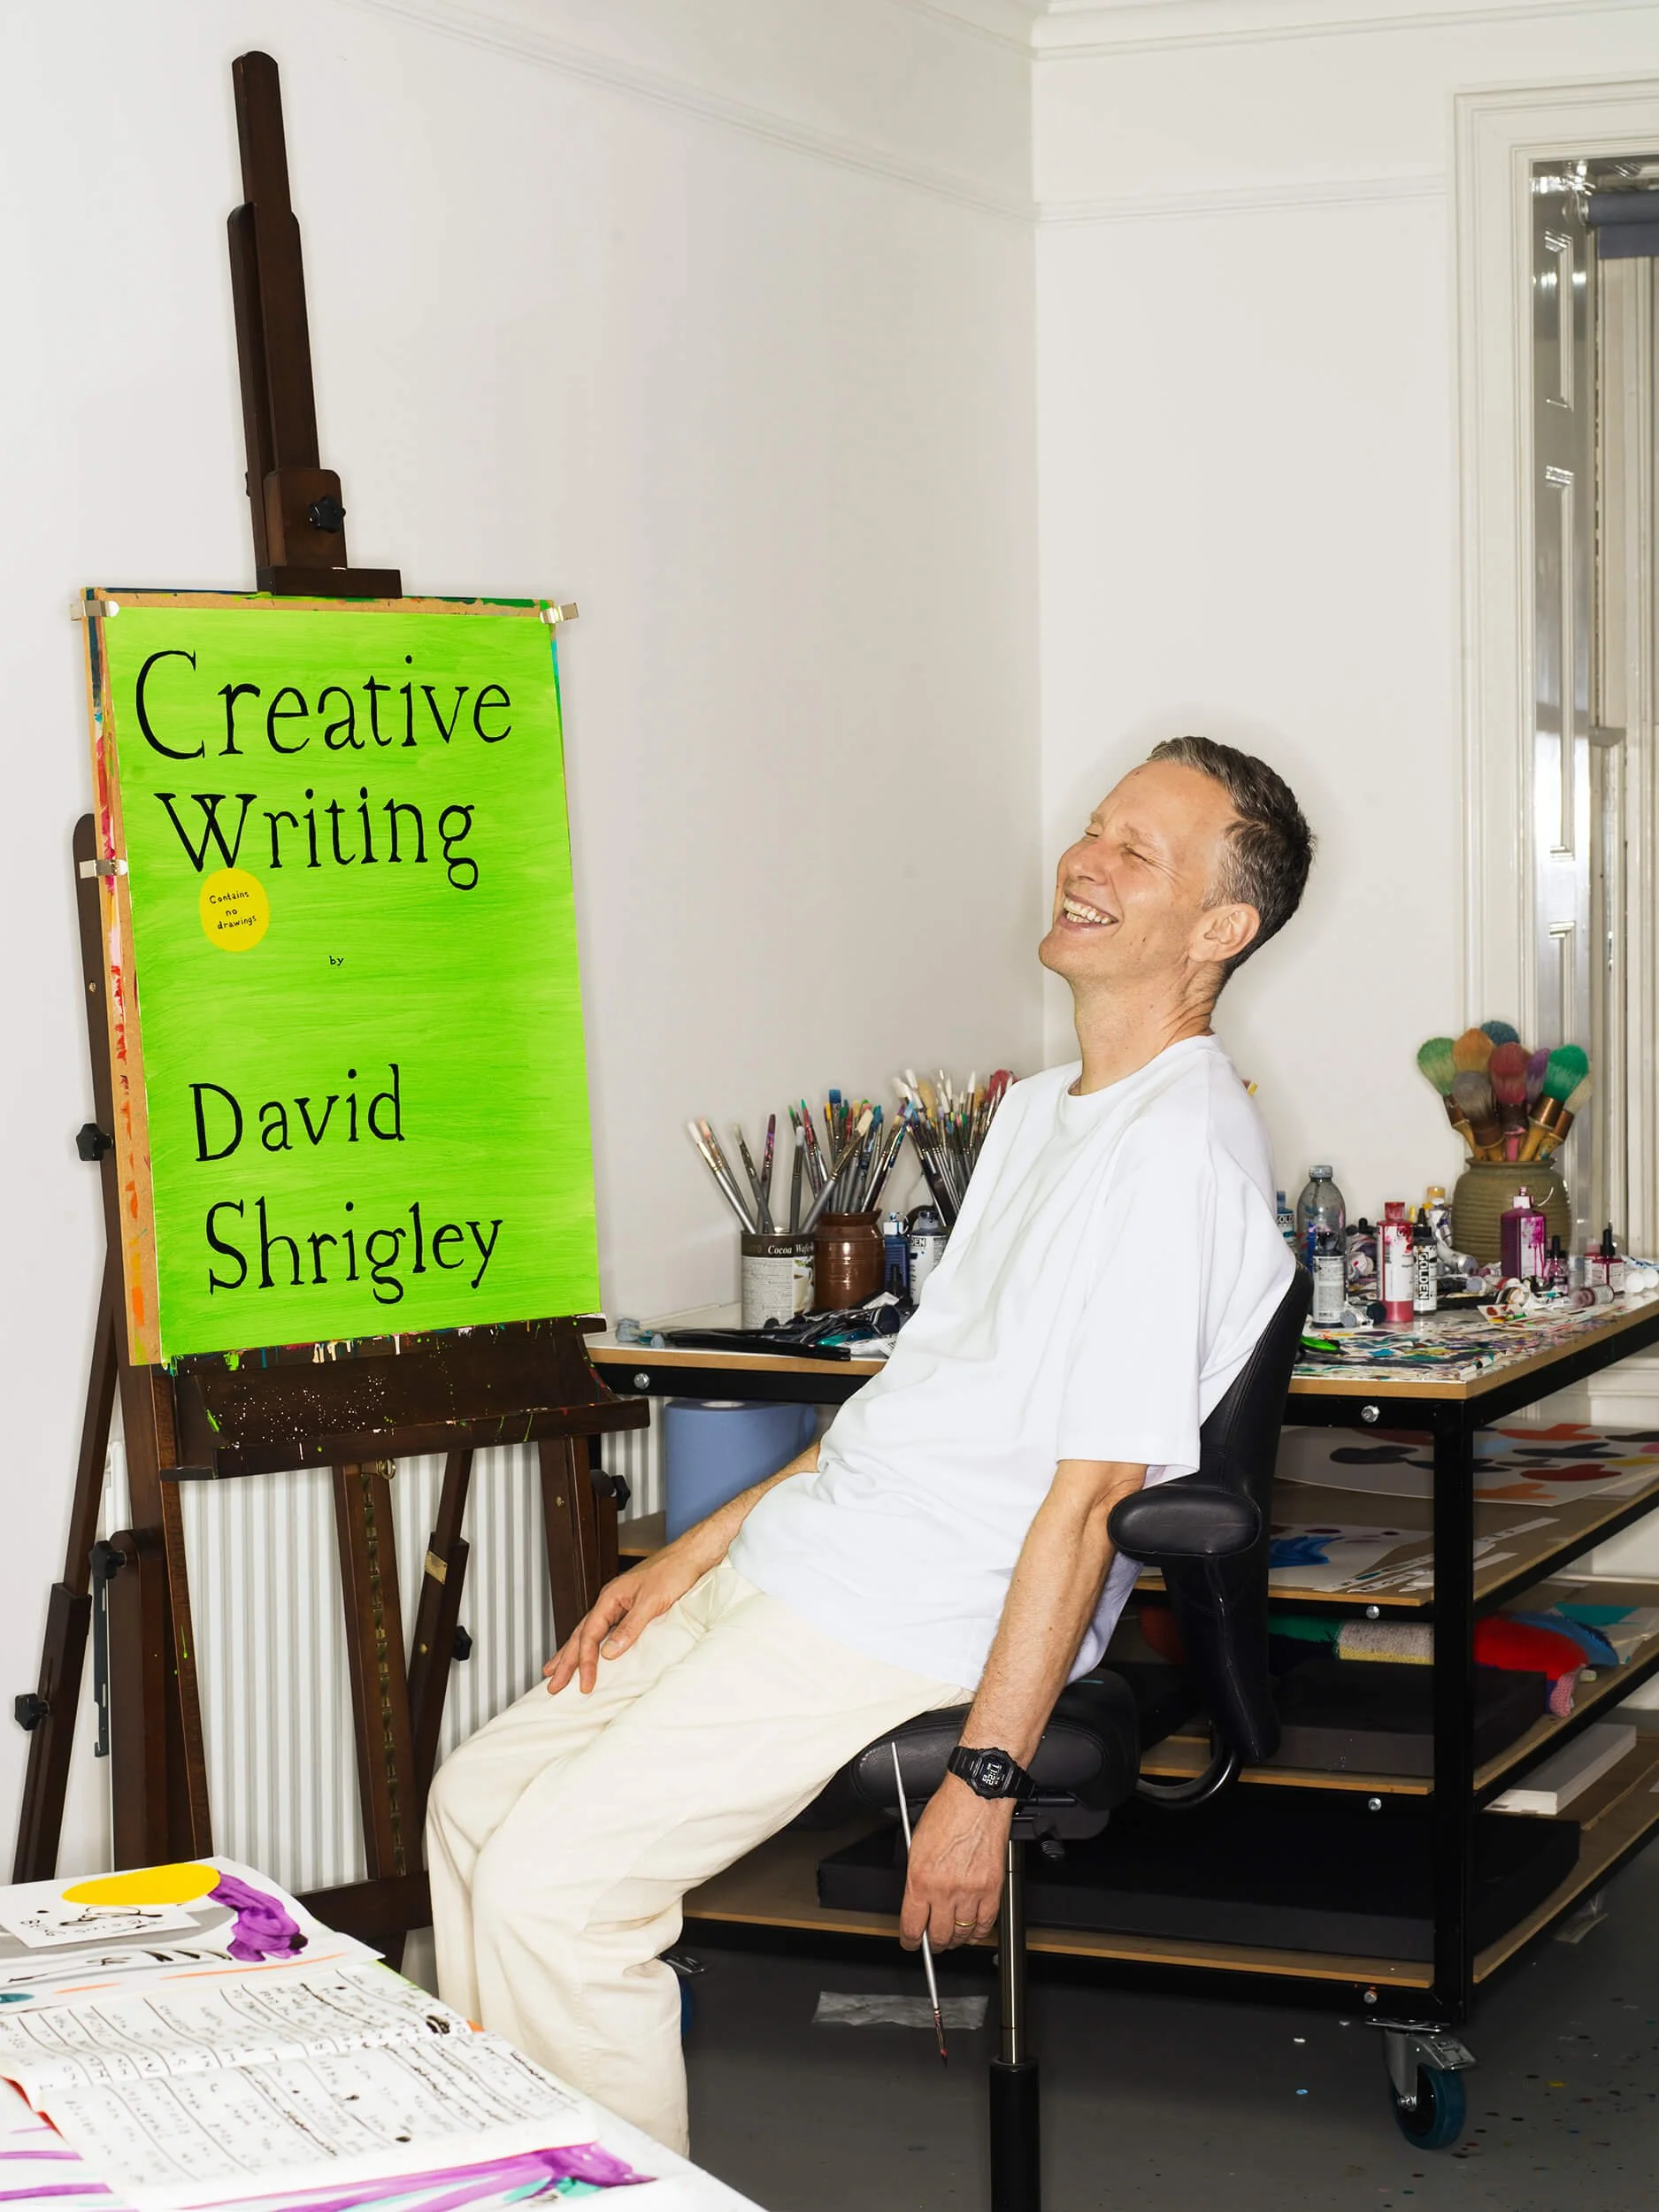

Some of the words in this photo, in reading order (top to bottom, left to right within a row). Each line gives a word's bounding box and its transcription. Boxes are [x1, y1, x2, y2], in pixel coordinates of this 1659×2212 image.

[135, 650, 511, 760] Creative
[153, 787, 479, 891] Writing
[209, 890, 250, 904] Contains
[217, 915, 257, 930] drawings
[329, 955, 344, 967] by
[188, 1064, 405, 1163] David
[206, 1196, 503, 1305] Shrigley
[767, 1245, 793, 1255] Cocoa
[1418, 1252, 1429, 1300] GOLDEN
